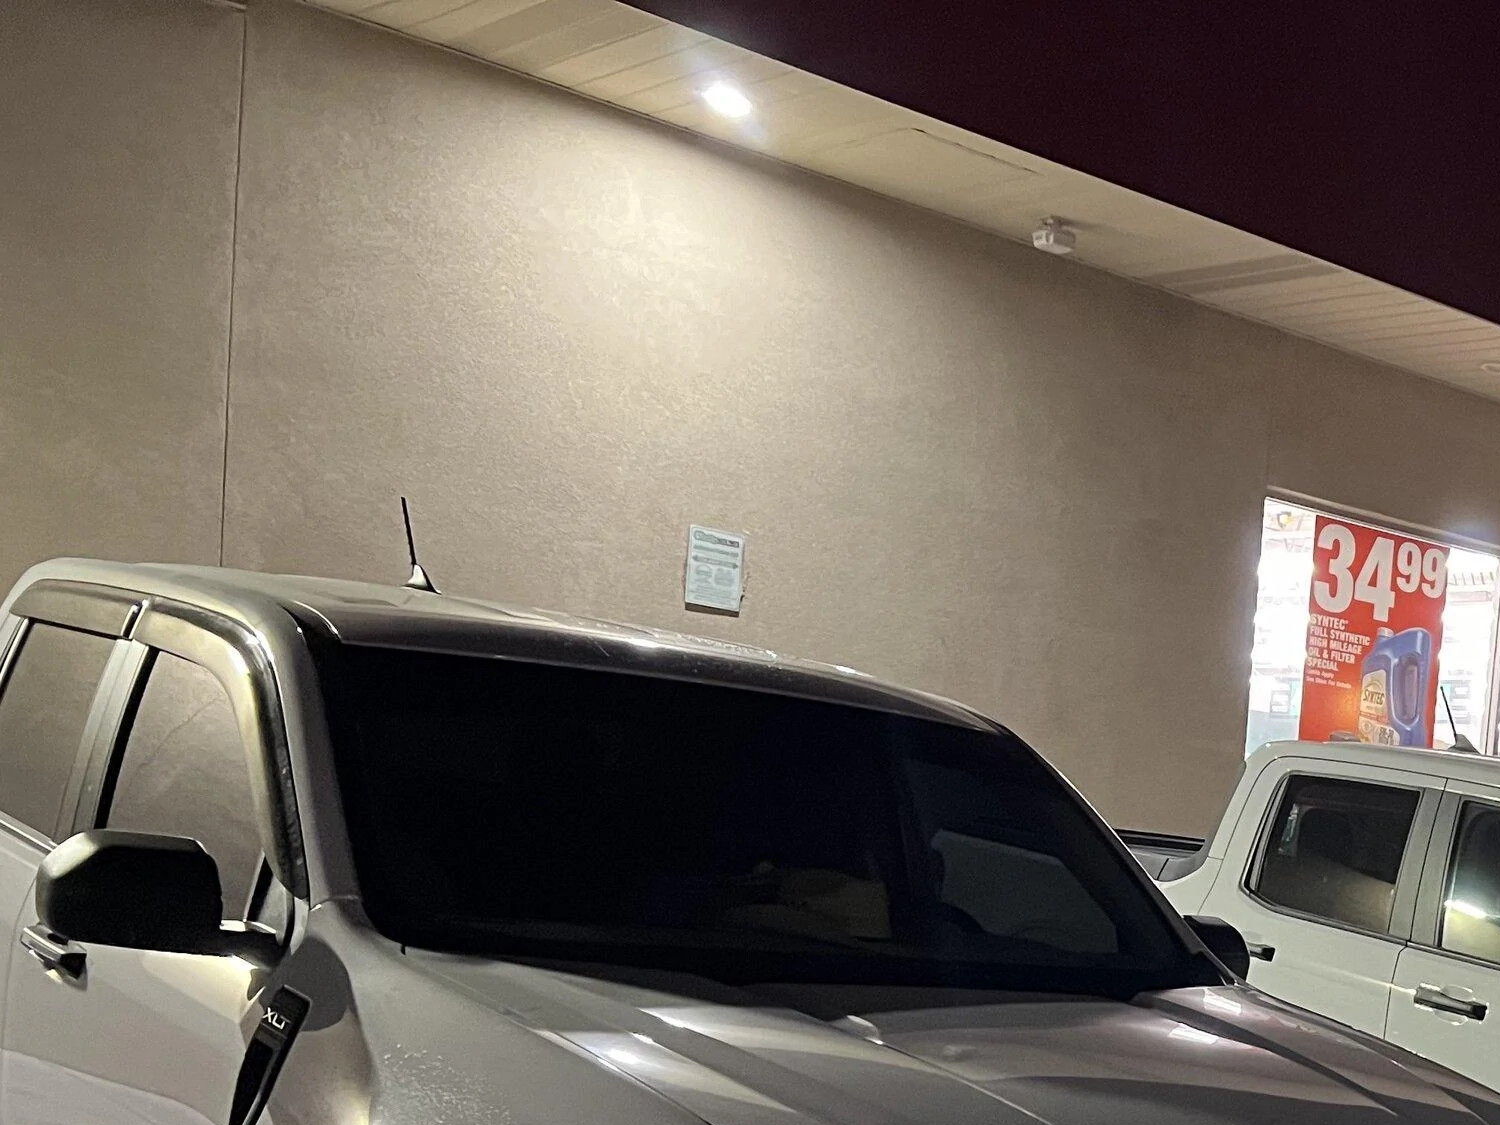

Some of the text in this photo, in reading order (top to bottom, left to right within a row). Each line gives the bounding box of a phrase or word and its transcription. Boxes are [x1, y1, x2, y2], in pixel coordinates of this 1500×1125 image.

[1308, 635, 1362, 654] HIGH MILEAGE
[1309, 625, 1371, 646] FULL SYNTHETIC
[1306, 656, 1339, 671] SPECIAL
[1331, 650, 1355, 664] FILTER
[262, 1006, 292, 1030] XLT
